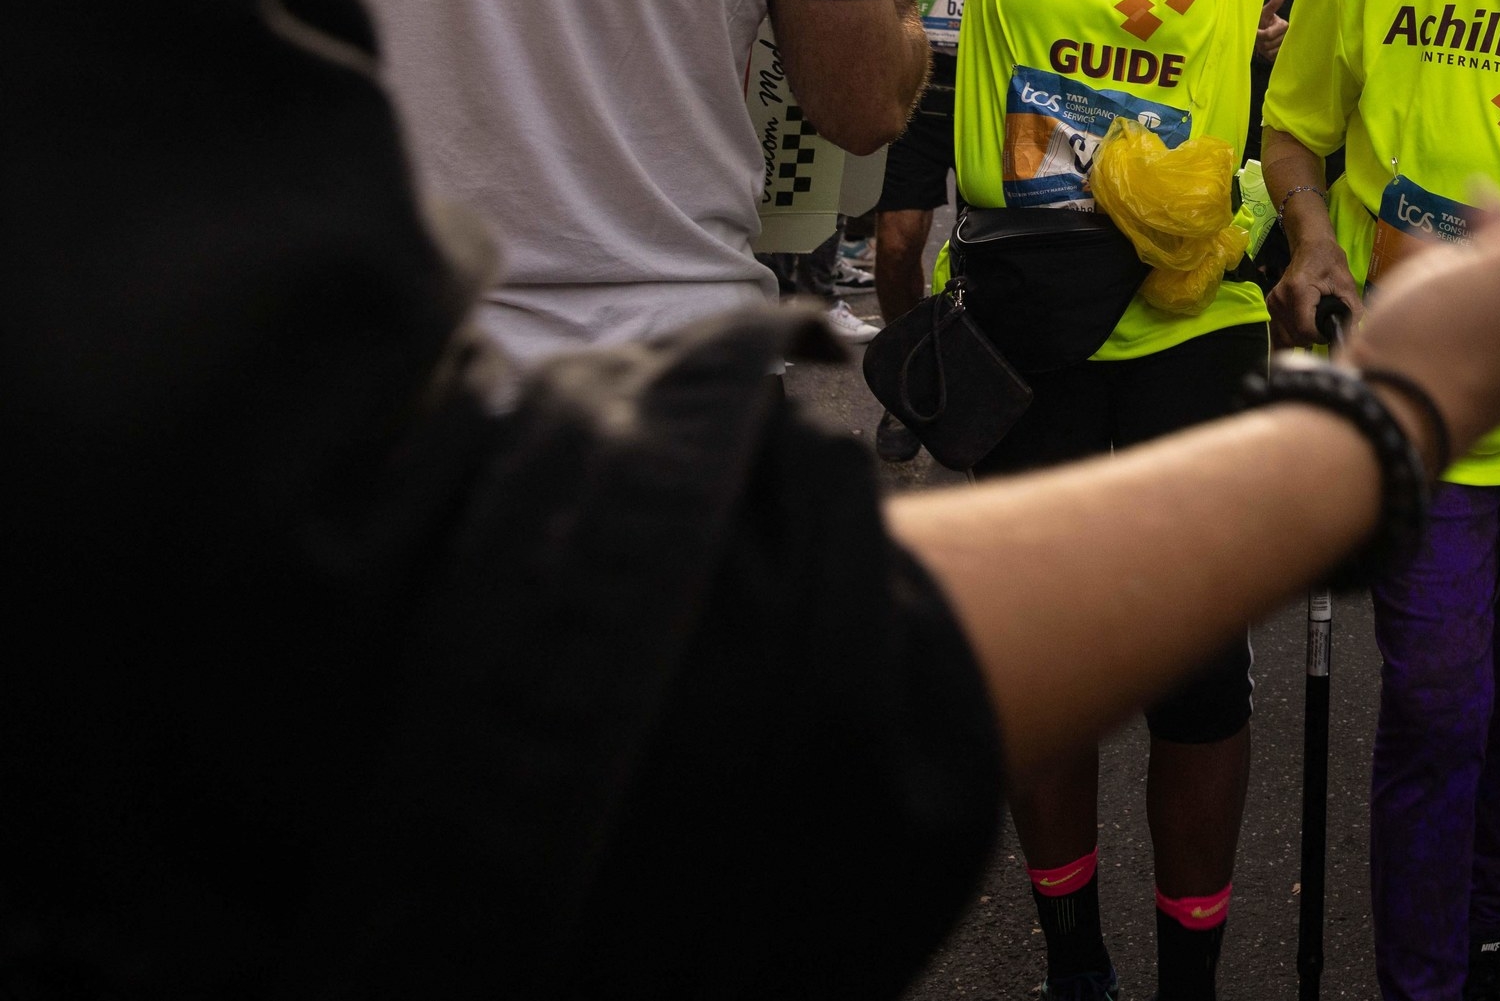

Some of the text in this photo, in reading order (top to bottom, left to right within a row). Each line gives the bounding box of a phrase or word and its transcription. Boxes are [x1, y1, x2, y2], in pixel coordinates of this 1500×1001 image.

[1049, 38, 1186, 88] GUIDE
[1020, 81, 1062, 113] tcs
[1066, 93, 1088, 105] TATA
[1065, 102, 1118, 121] CONSULTANCY
[1397, 193, 1435, 233] tcs
[1441, 212, 1467, 228] TATA
